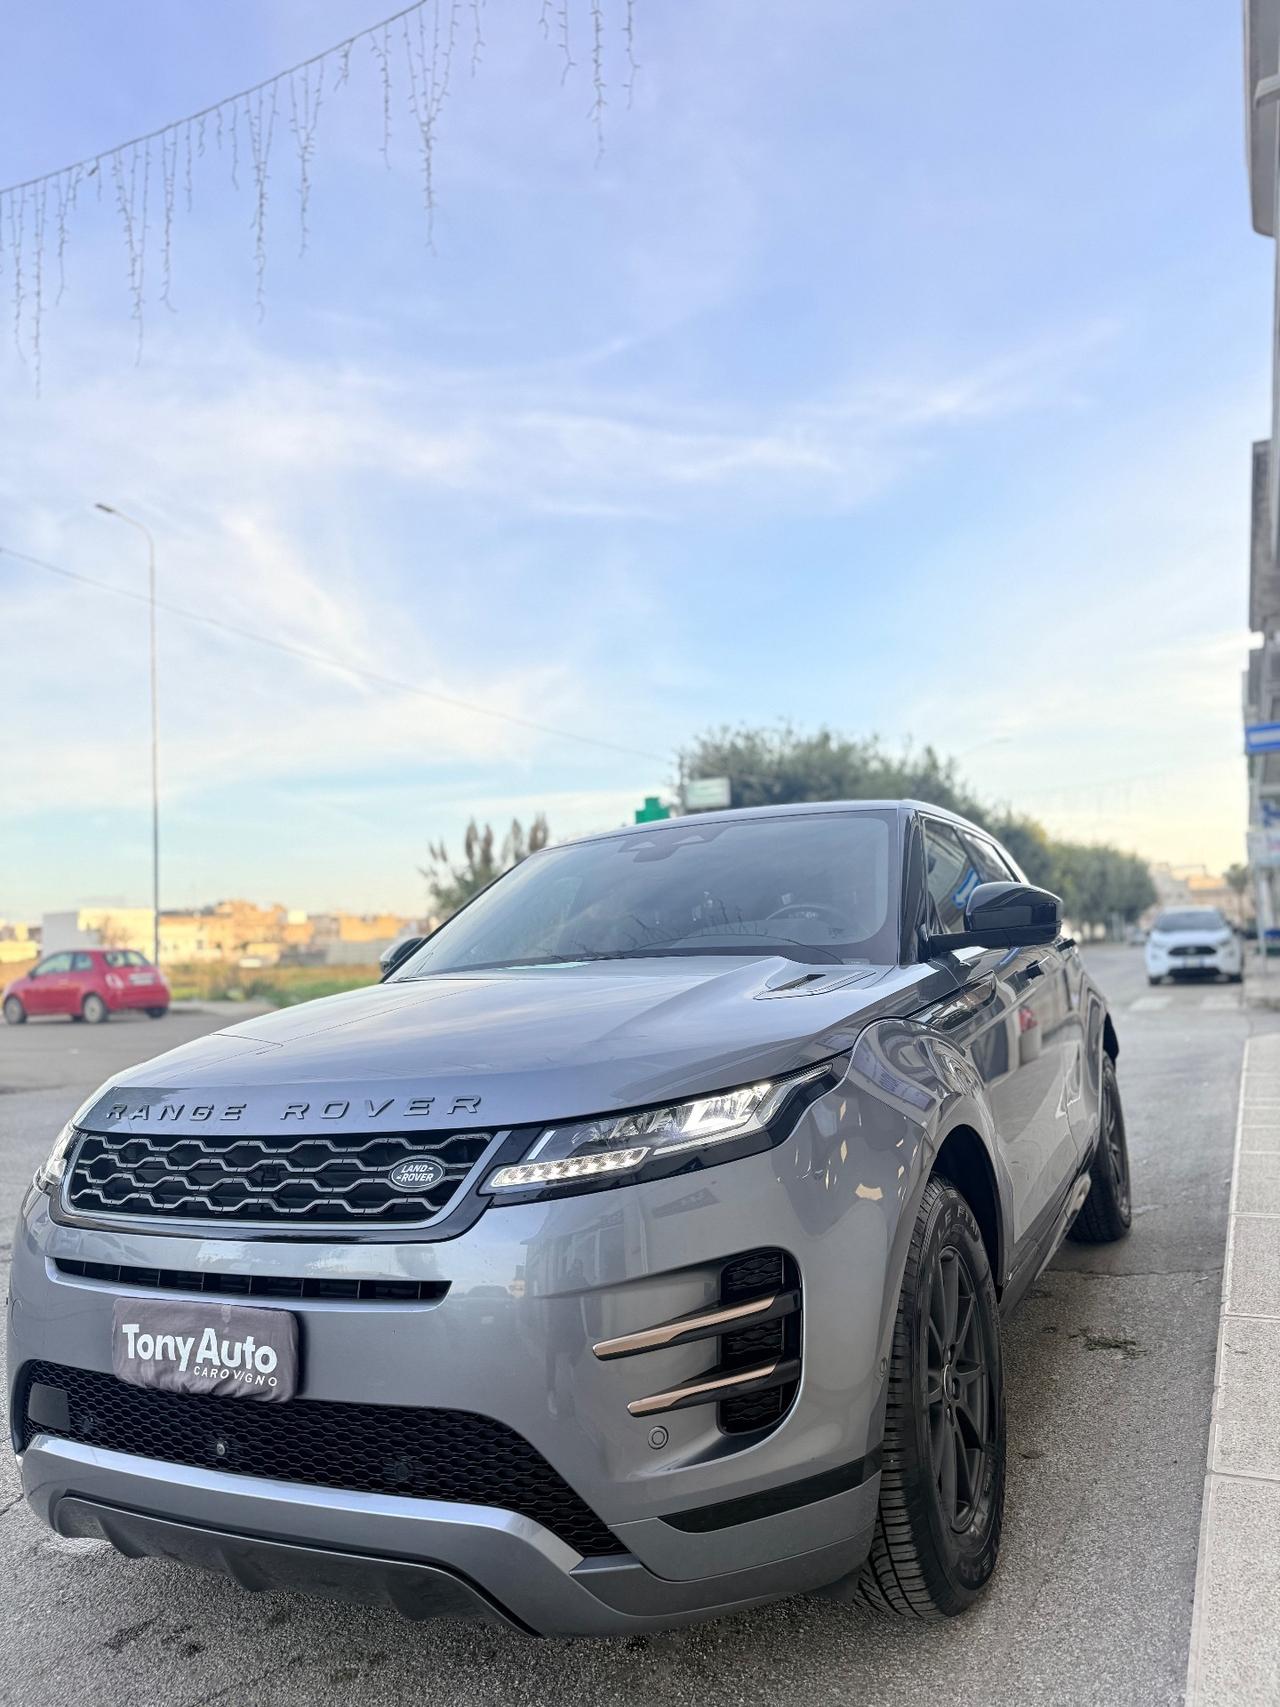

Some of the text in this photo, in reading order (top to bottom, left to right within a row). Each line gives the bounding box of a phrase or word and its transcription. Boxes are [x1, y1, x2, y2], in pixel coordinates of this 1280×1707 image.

[106, 1095, 482, 1121] RANGE ROVER
[400, 1173, 434, 1182] ROVER
[193, 1366, 278, 1387] CAROVIGNO
